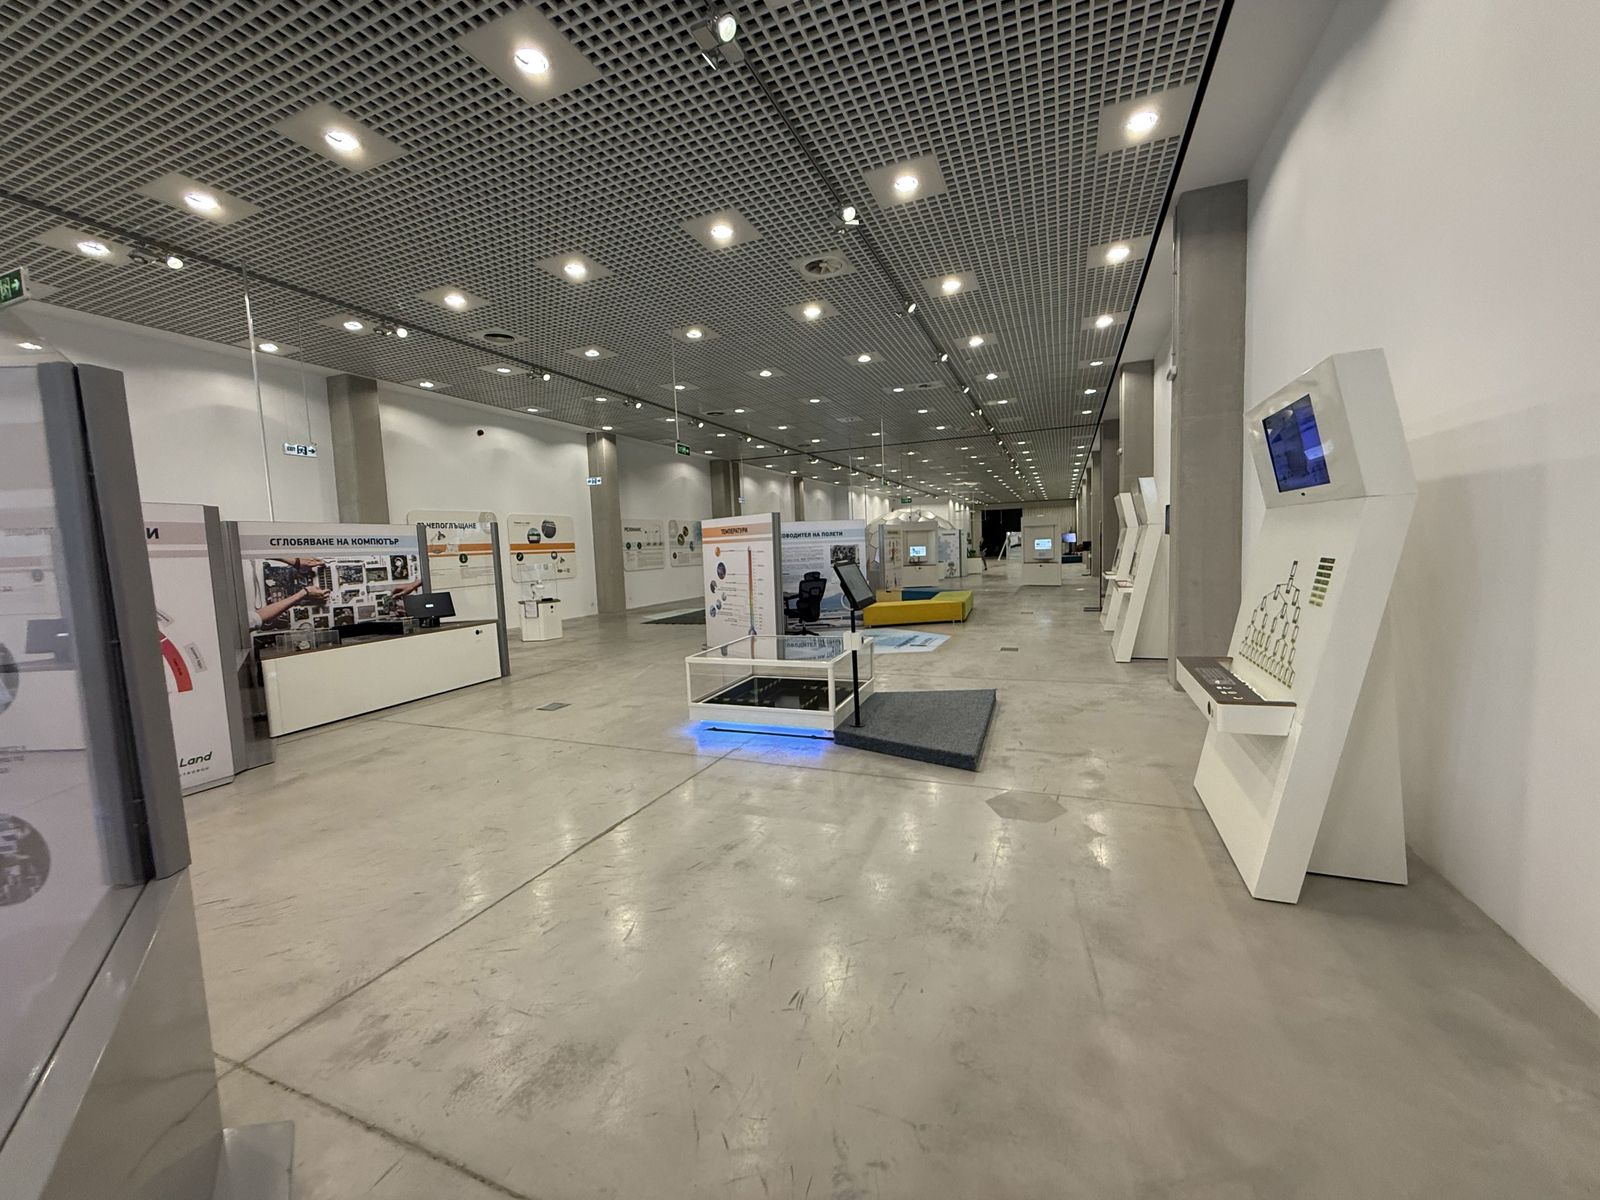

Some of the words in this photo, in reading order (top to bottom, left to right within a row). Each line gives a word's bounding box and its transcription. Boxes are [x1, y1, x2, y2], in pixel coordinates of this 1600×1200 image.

[417, 522, 477, 530] ЧЕПОГЛЪЩАНЕ
[269, 537, 335, 547] СГЛОБЯВАНЕ
[336, 537, 350, 546] НА
[351, 537, 400, 546] КОМПЮТЪР
[179, 751, 213, 768] Land
